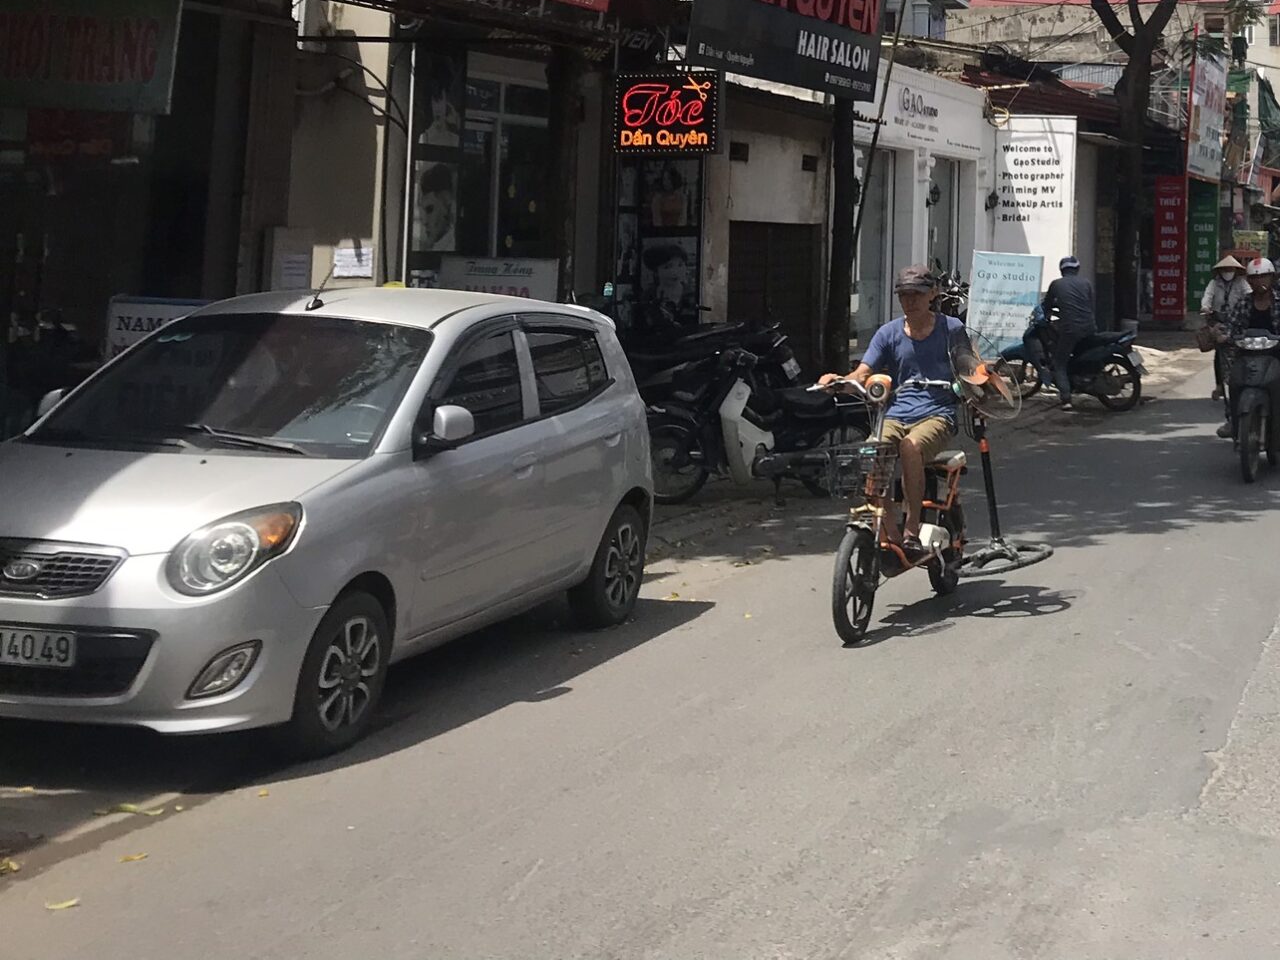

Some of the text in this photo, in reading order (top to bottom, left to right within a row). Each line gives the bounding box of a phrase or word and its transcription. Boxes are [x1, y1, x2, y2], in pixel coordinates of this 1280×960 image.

[797, 29, 871, 73] HAIR SALON
[622, 83, 704, 127] Tóc
[620, 128, 708, 148] Dần Quyên
[1002, 186, 1056, 195] Filming MV
[1002, 200, 1038, 208] MakeUp
[1002, 214, 1030, 222] Bridal
[1002, 271, 1036, 282] studio
